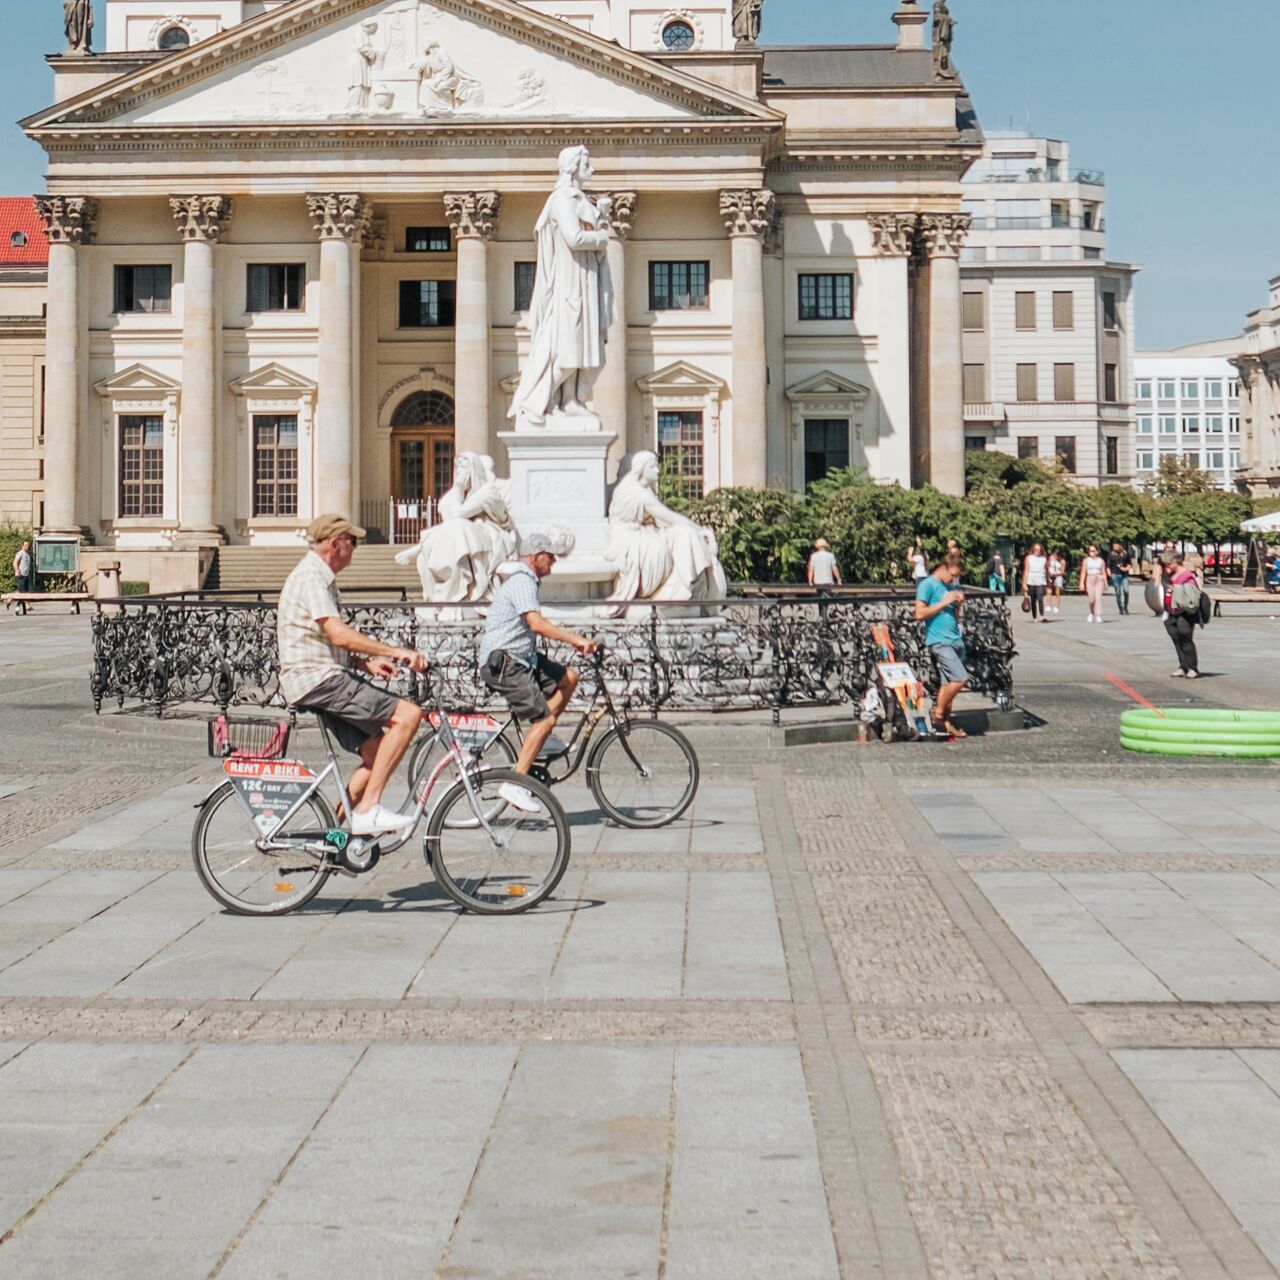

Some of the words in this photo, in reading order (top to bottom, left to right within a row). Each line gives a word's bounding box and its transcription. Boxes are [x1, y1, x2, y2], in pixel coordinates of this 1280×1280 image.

[230, 762, 260, 774] RENT
[262, 764, 272, 776] A
[274, 765, 300, 776] BIKE
[241, 779, 263, 791] 12€
[267, 785, 281, 793] DAY
